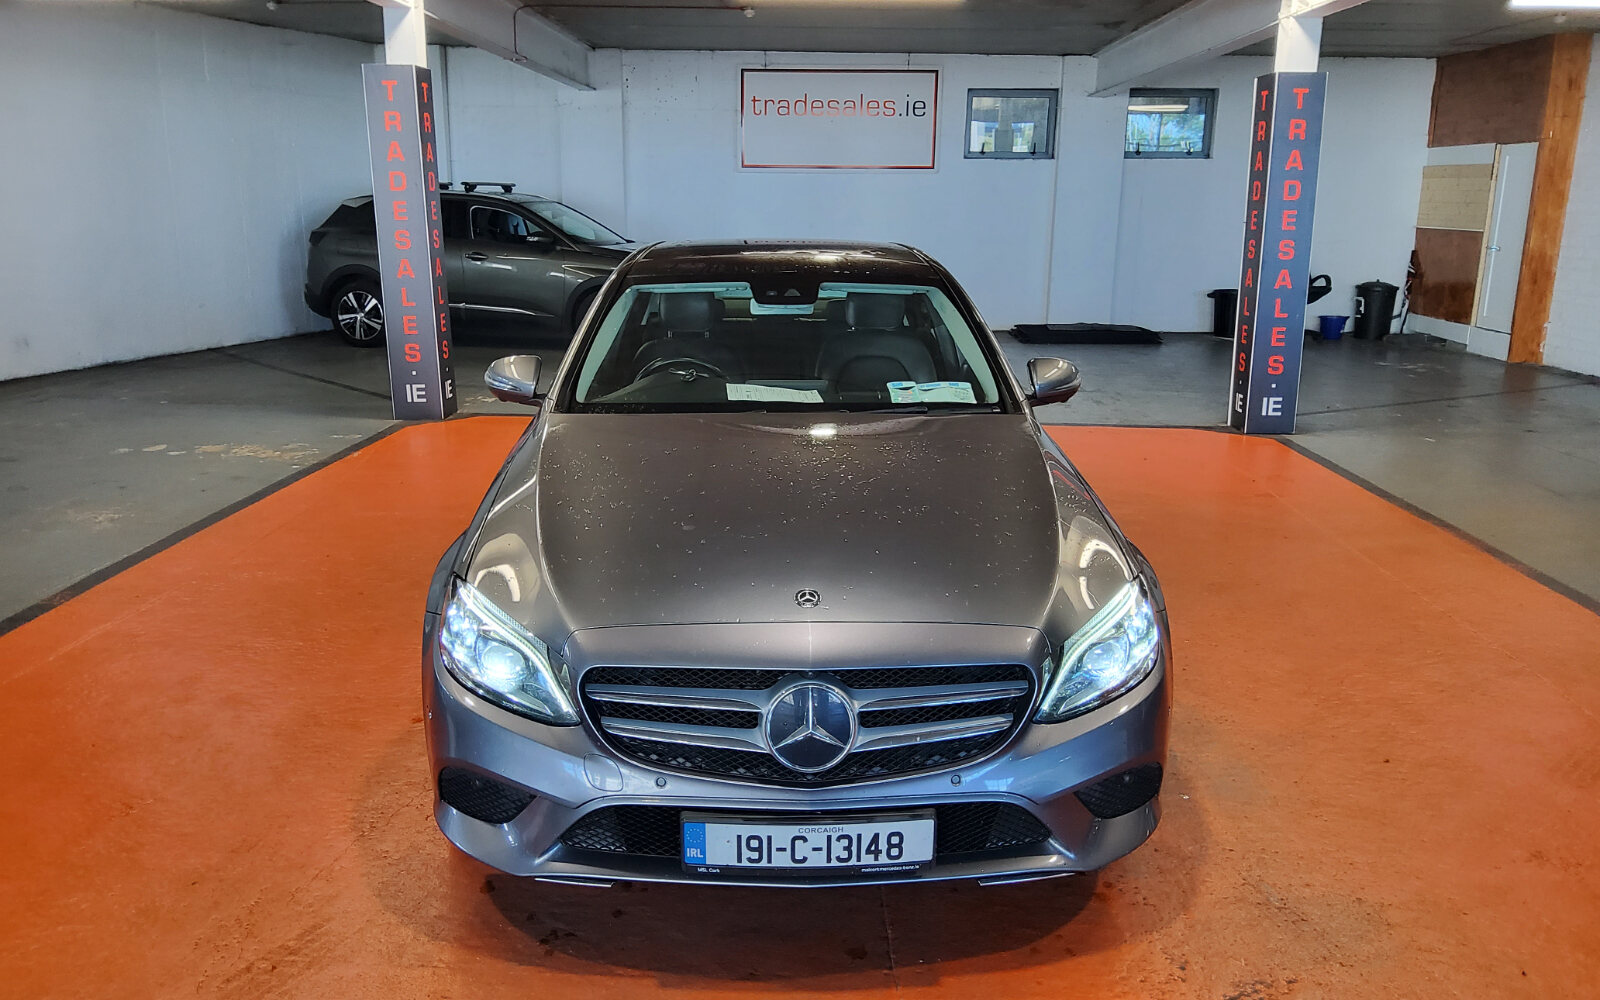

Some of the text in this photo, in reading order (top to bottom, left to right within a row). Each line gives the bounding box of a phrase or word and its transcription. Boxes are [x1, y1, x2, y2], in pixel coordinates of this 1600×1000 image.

[751, 93, 927, 117] tradesales.ie
[798, 826, 844, 834] CORCAIGH
[686, 847, 704, 858] IRL
[736, 831, 905, 864] 191-C-13148
